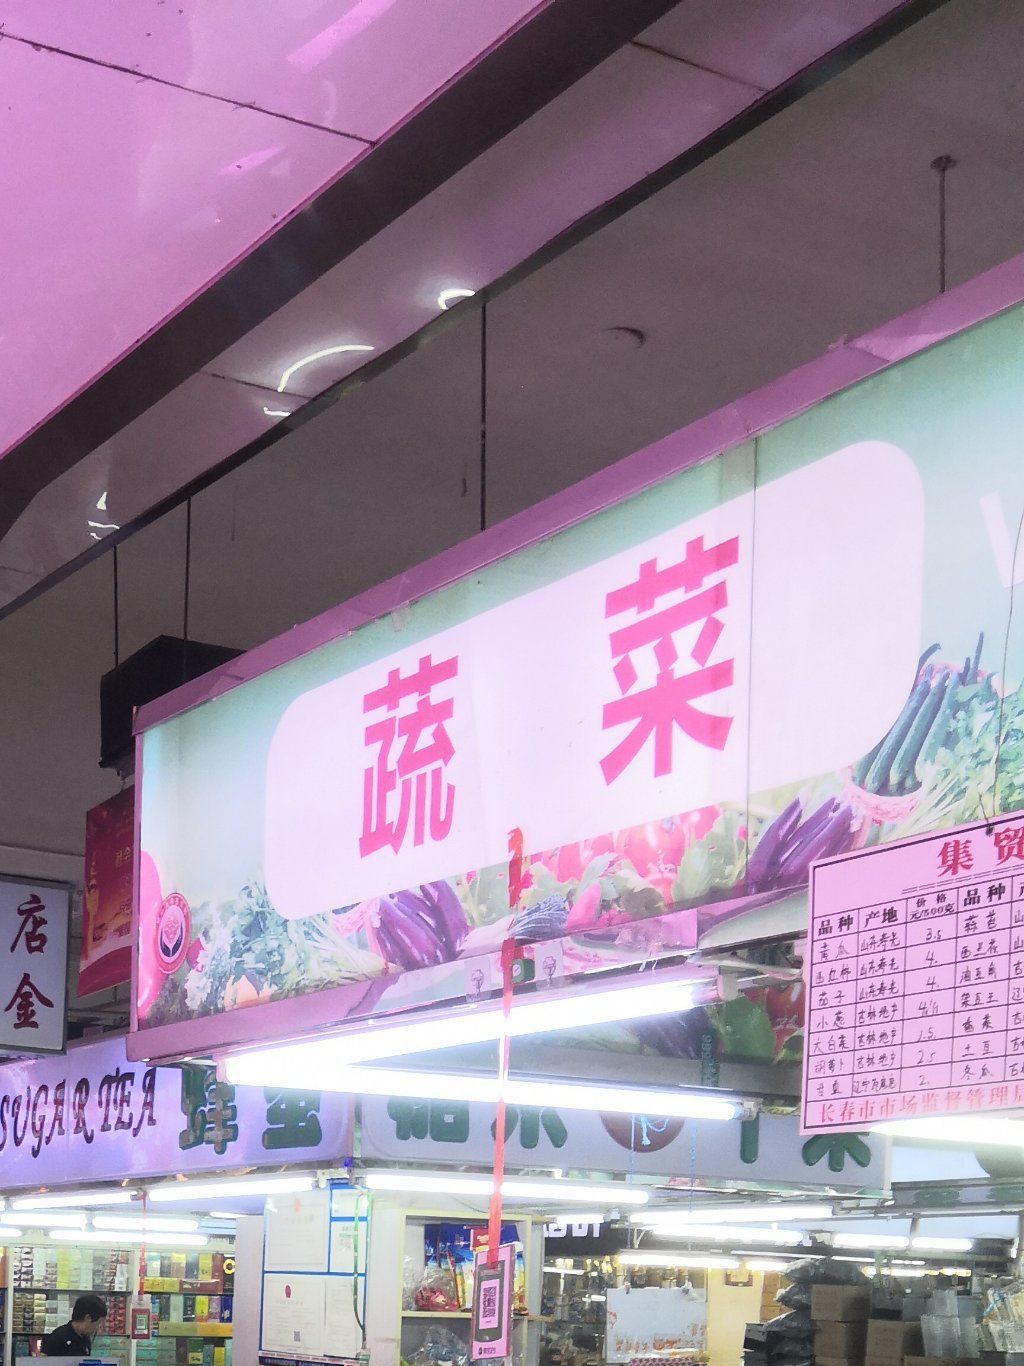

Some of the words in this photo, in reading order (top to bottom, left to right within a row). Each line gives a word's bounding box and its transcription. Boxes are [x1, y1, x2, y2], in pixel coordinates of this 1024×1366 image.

[359, 534, 740, 860] 蔬菜
[818, 914, 854, 936] 品种
[864, 906, 899, 929] 产地
[963, 883, 1006, 907] 品种
[910, 903, 955, 920] 元/500克
[97, 1066, 158, 1138] TEA
